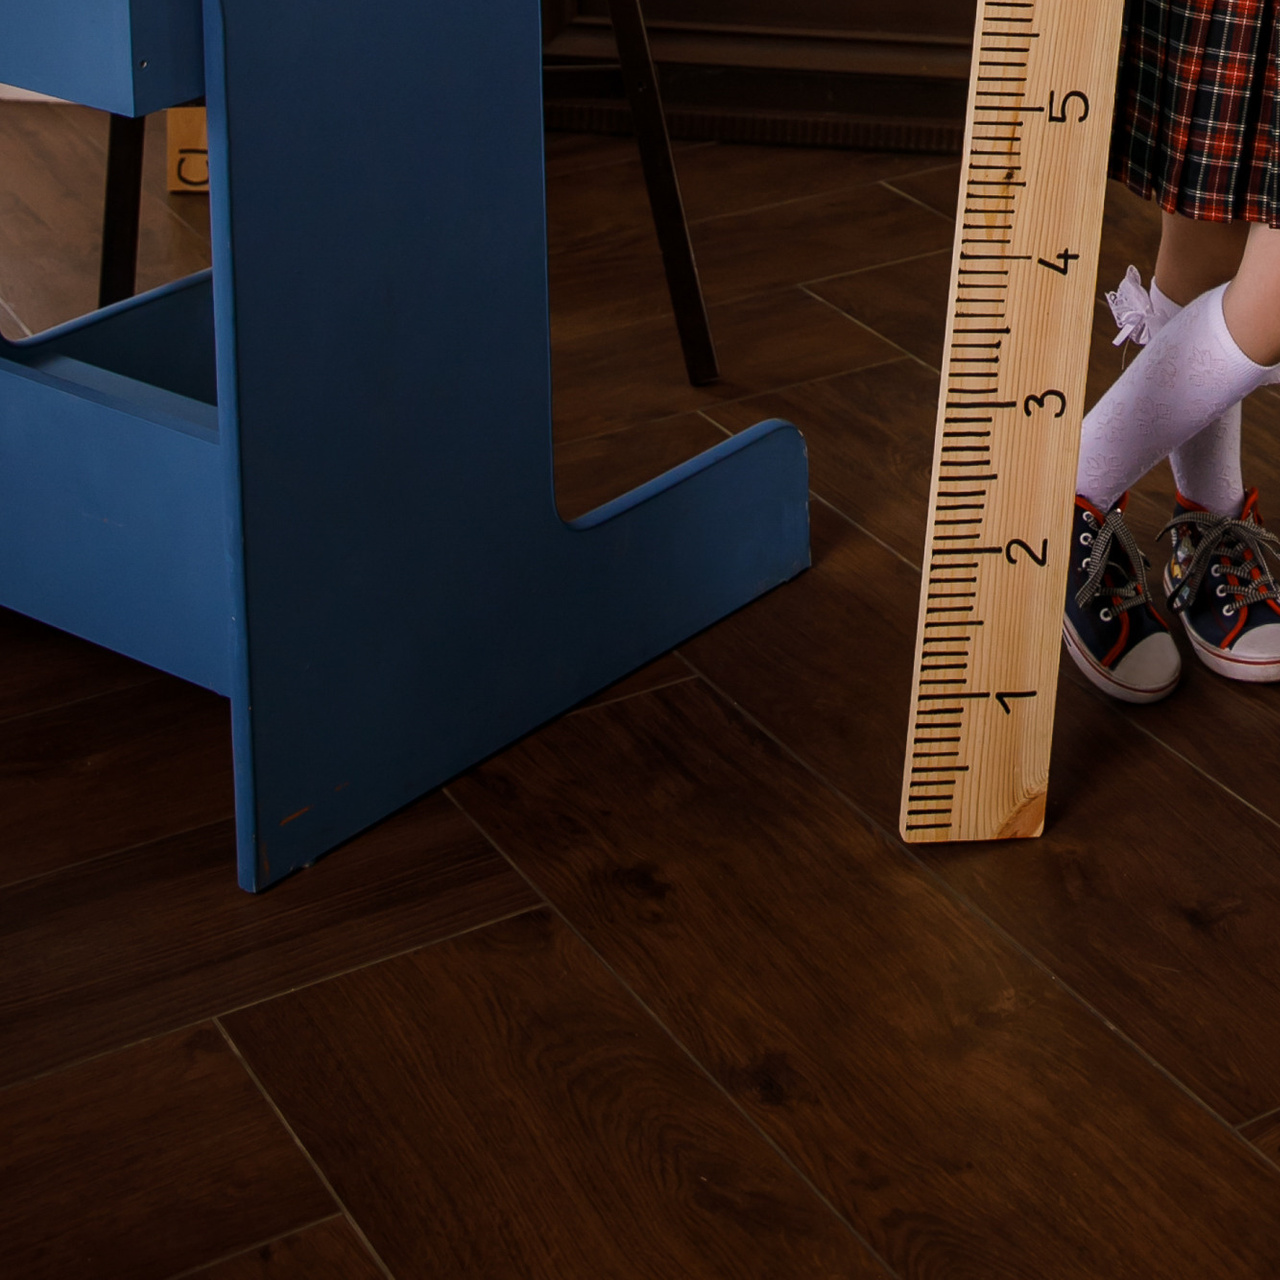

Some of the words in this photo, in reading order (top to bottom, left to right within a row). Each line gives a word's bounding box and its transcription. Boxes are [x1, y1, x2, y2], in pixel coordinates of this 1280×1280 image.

[1047, 89, 1090, 124] 5
[1037, 247, 1080, 276] 4
[1023, 389, 1067, 419] 3
[1005, 538, 1049, 568] 2
[994, 690, 1038, 716] 1
